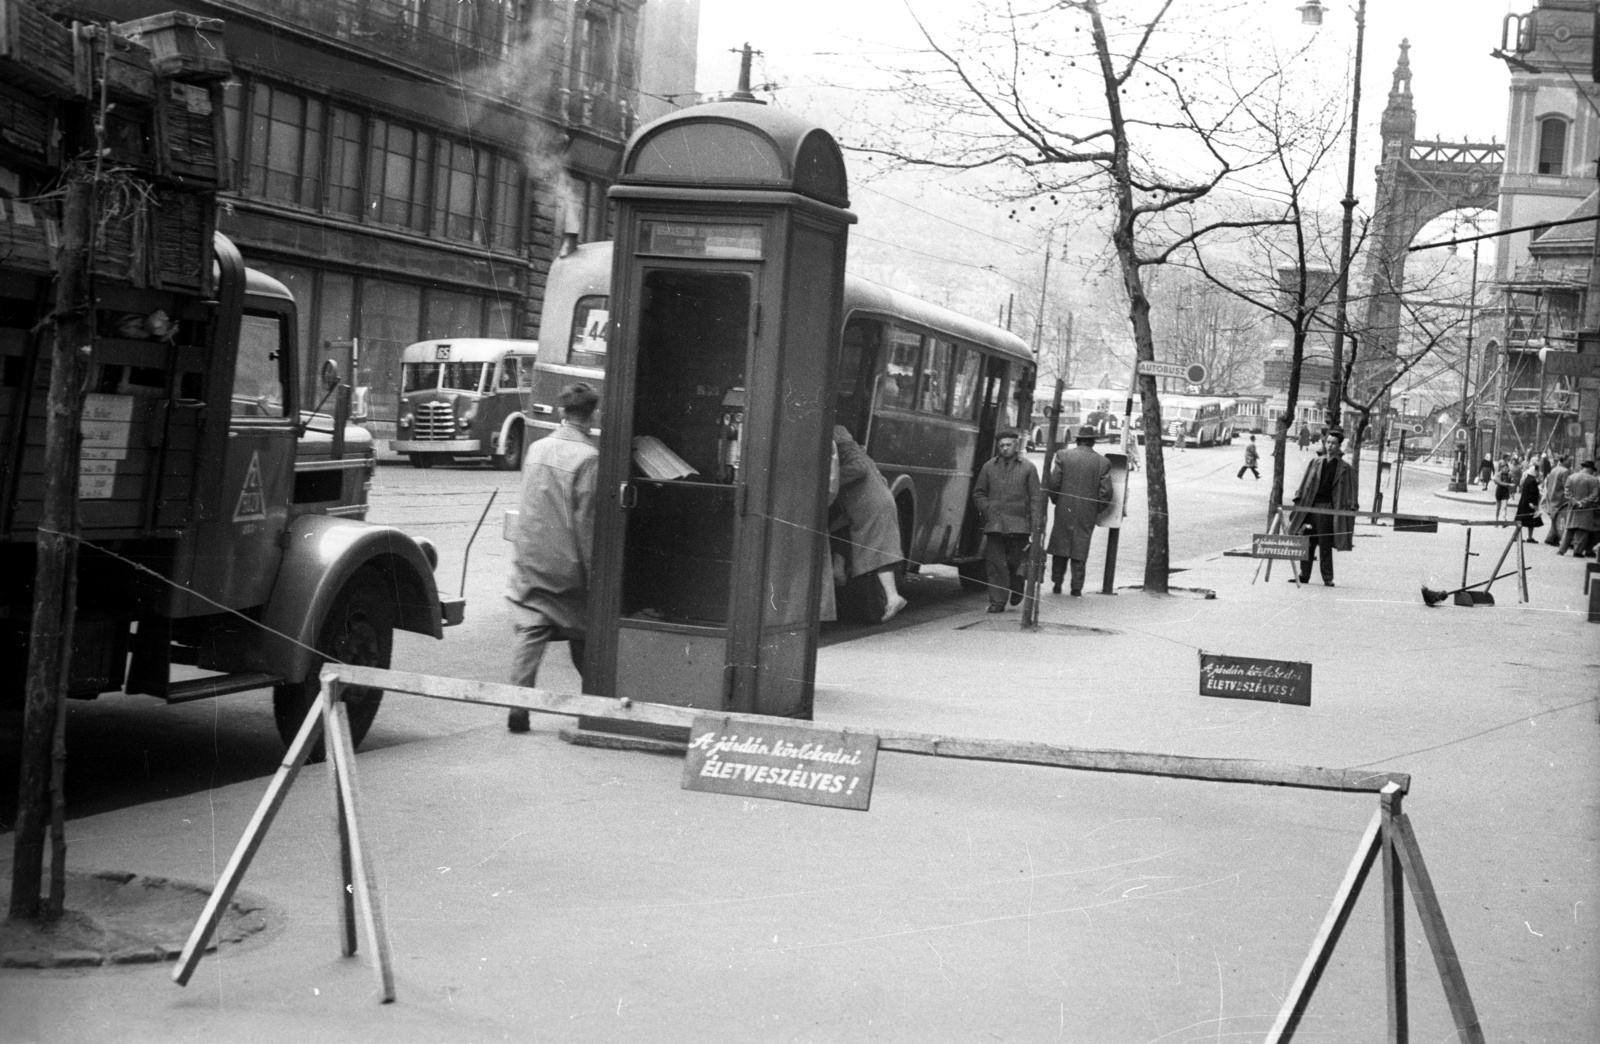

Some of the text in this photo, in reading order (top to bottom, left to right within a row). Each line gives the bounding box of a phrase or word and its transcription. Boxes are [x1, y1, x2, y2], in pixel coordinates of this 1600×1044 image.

[589, 321, 609, 342] 44
[1140, 364, 1186, 375] AUTOBUSZ
[1201, 663, 1303, 681] A járdán közlekedni
[688, 732, 862, 766] A járdán közlekedni
